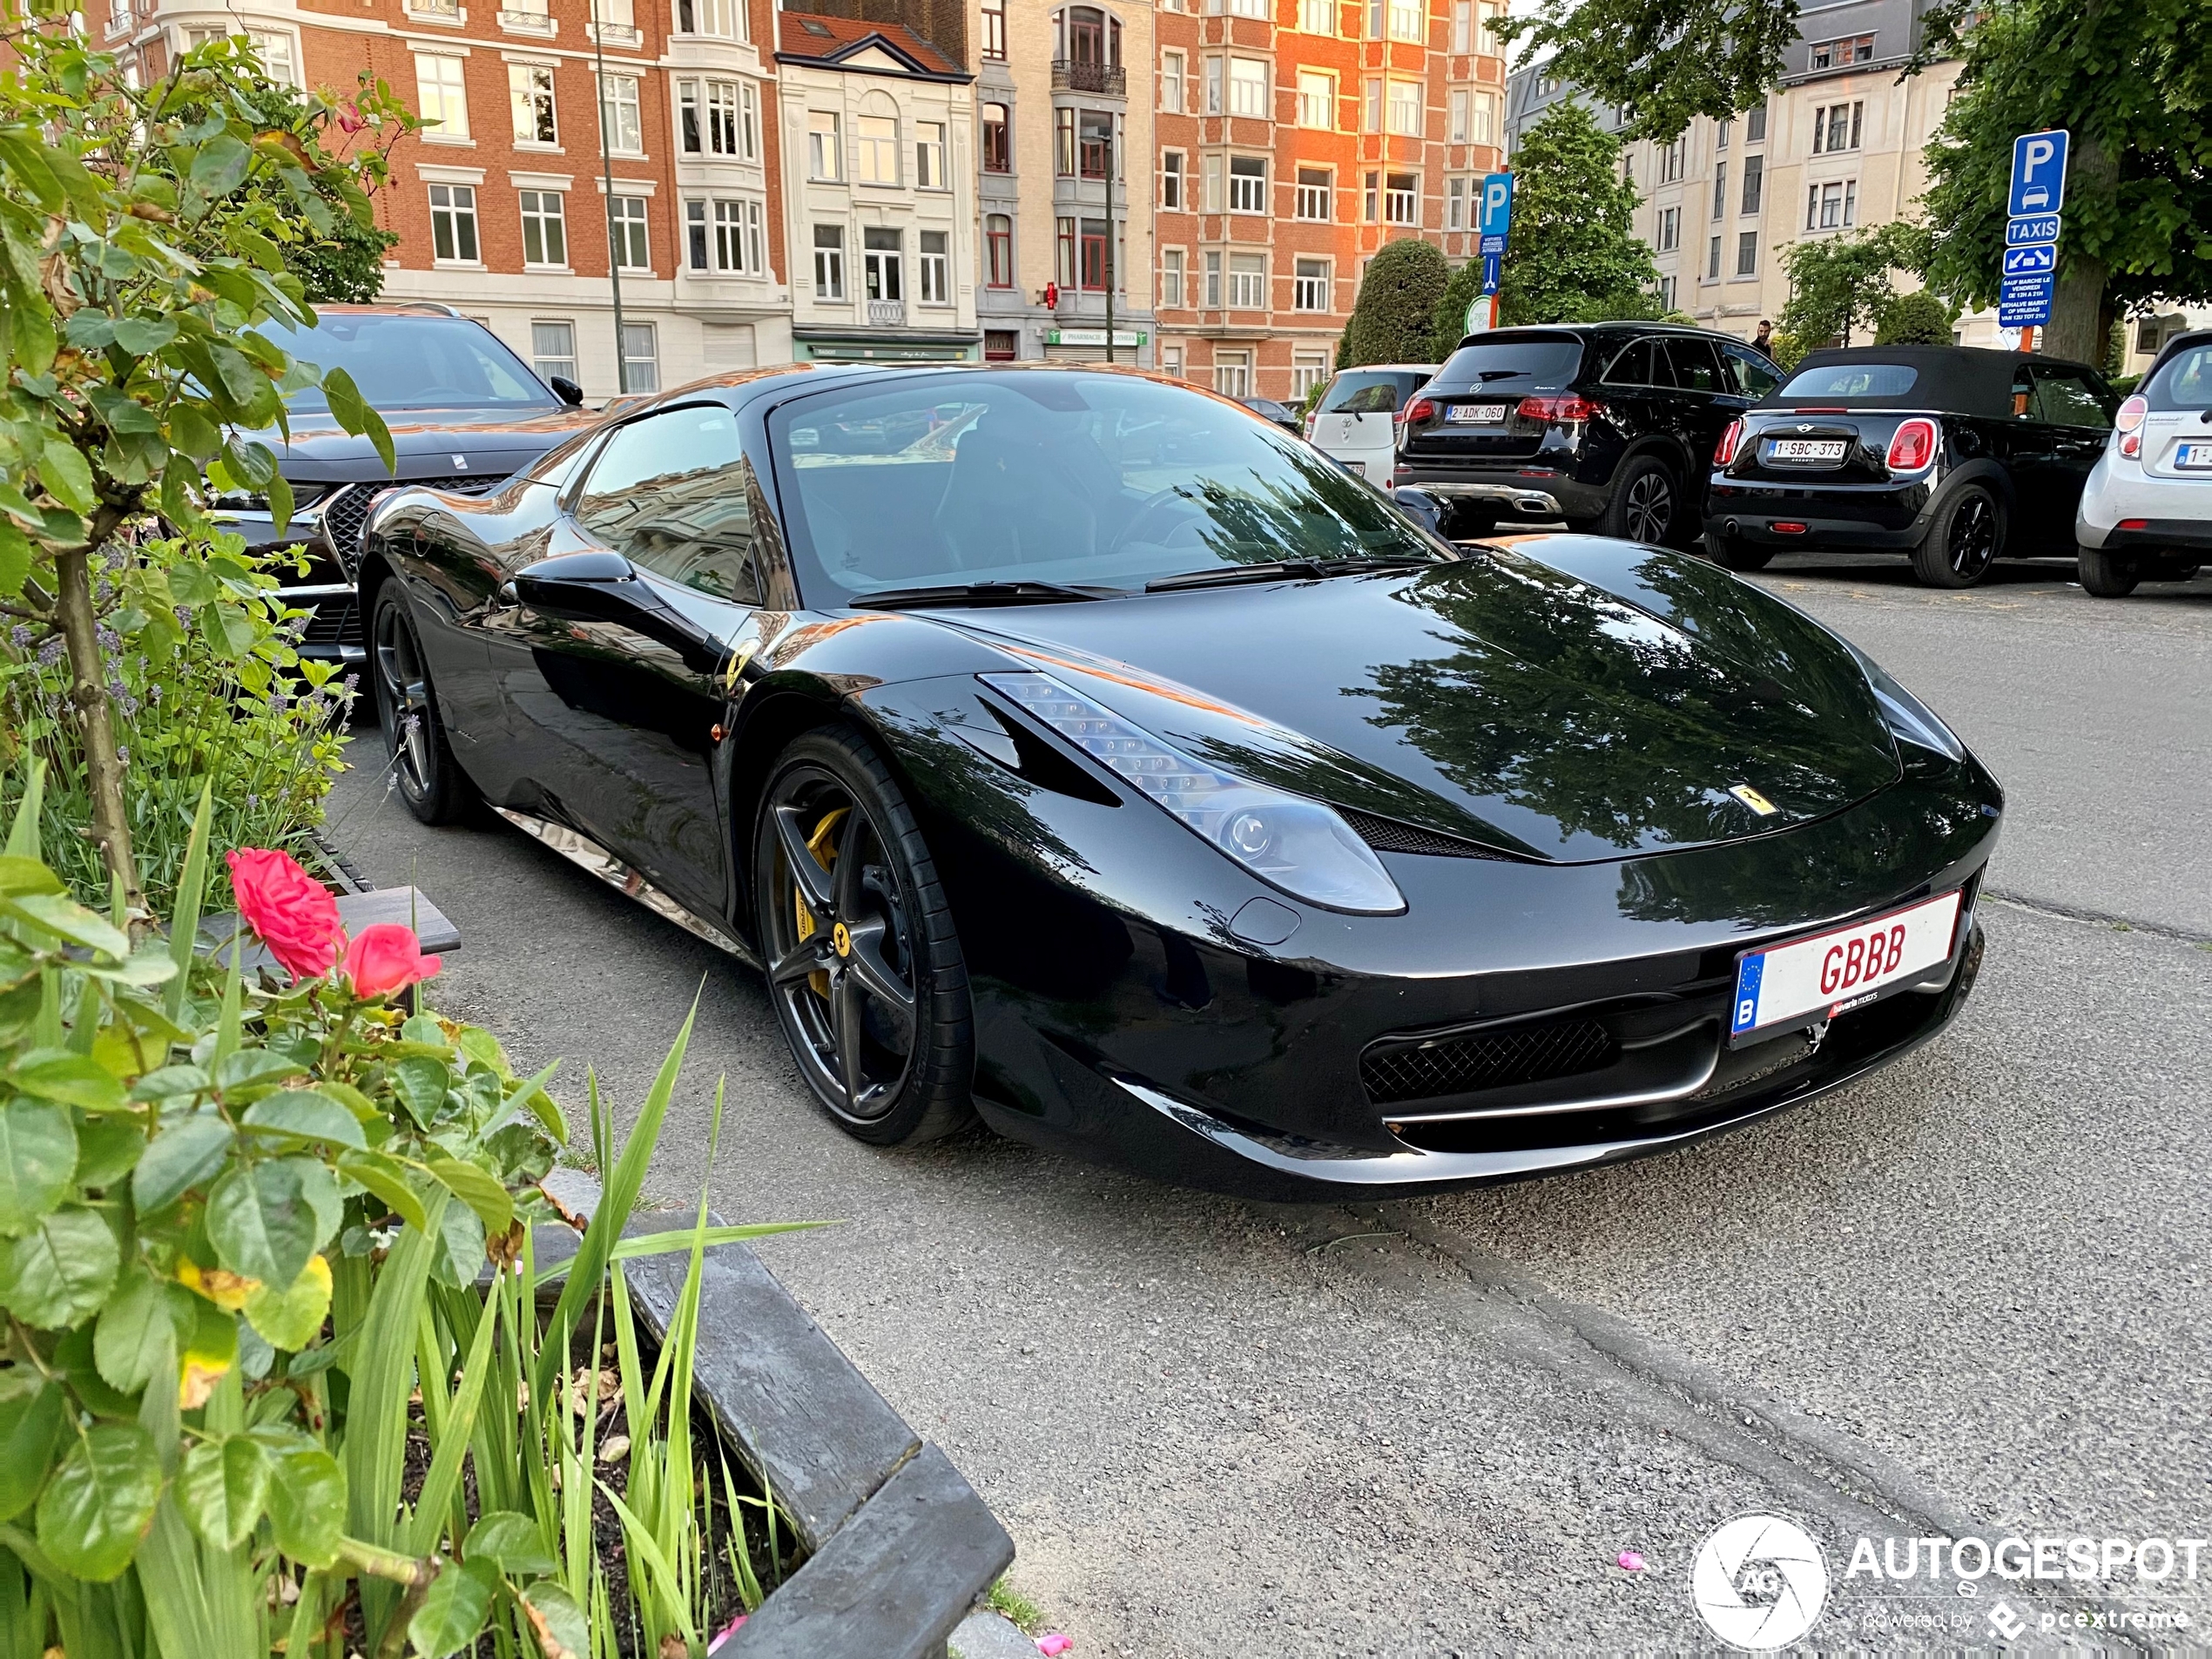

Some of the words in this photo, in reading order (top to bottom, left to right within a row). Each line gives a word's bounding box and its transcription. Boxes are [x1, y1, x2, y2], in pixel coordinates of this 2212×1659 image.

[2024, 139, 2054, 184] P
[1485, 183, 1507, 226] P
[2010, 221, 2056, 239] TAXIS
[1820, 924, 1906, 995] GBBB
[1737, 999, 1754, 1025] B
[1833, 998, 1858, 1014] bavaria
[1858, 992, 1878, 1005] motors
